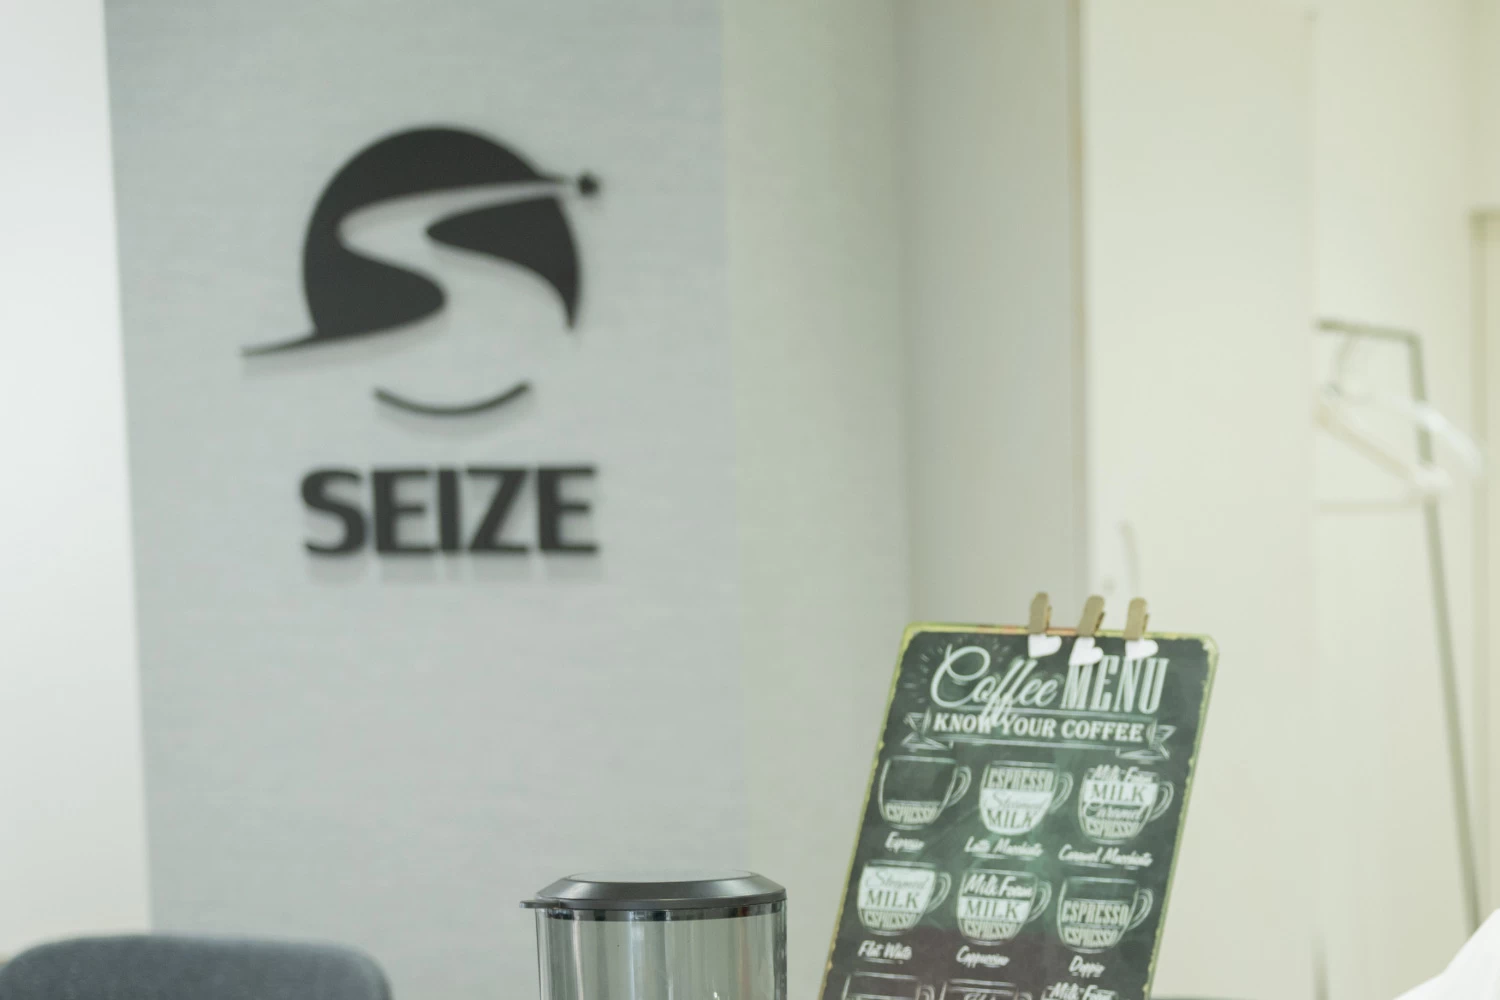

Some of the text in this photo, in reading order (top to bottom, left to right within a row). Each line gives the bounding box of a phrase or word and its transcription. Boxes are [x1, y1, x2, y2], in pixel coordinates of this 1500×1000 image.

[300, 465, 599, 556] SEIZE
[931, 643, 1170, 728] Coffee MENU
[933, 711, 1145, 743] KNOW YOUR COFFEE
[986, 767, 1054, 792] ESPRESSO
[1091, 782, 1145, 804] MILK
[987, 808, 1038, 829] MILK
[964, 873, 998, 896] Milk
[865, 889, 918, 909] MILK
[965, 900, 1018, 920] MILK
[1062, 900, 1130, 926] ESPRESSO
[1064, 926, 1120, 948] ESPRESSO
[858, 940, 884, 957] Flat
[1050, 982, 1080, 1000] Milk
